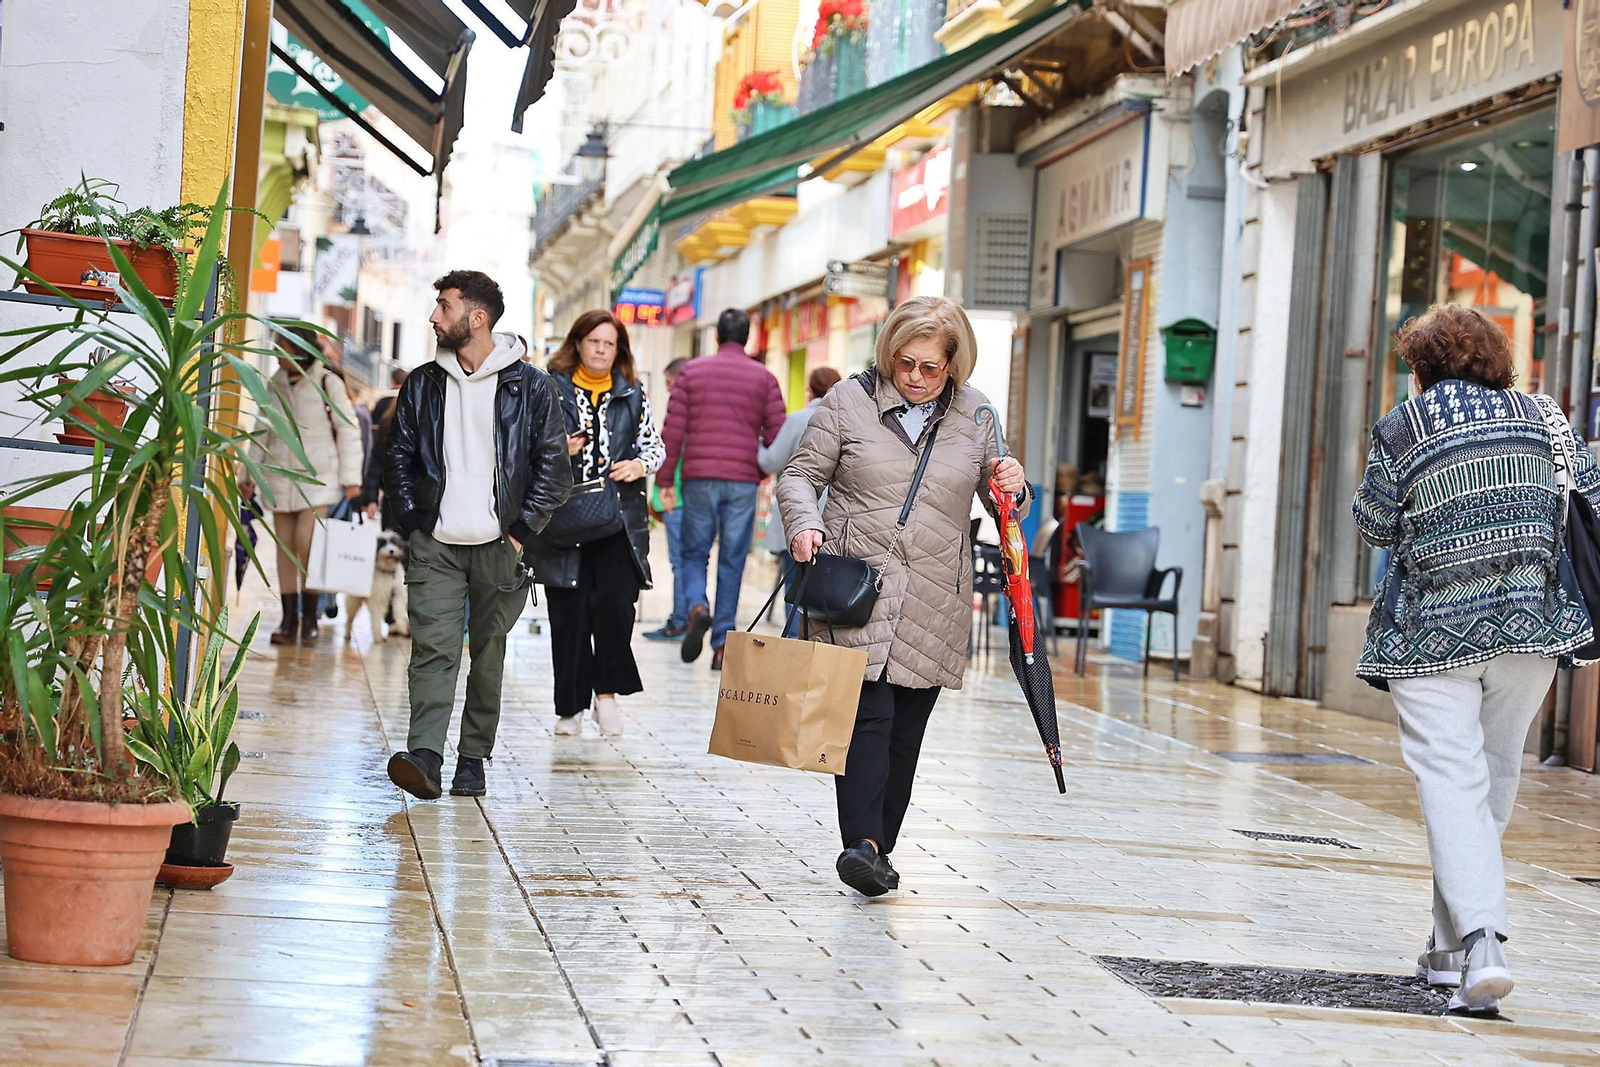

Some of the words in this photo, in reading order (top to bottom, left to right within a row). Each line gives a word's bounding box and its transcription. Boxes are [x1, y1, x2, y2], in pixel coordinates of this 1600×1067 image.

[1343, 45, 1417, 134] BAZAR
[1429, 0, 1536, 102] EUROPA
[719, 688, 778, 705] SCALPERS
